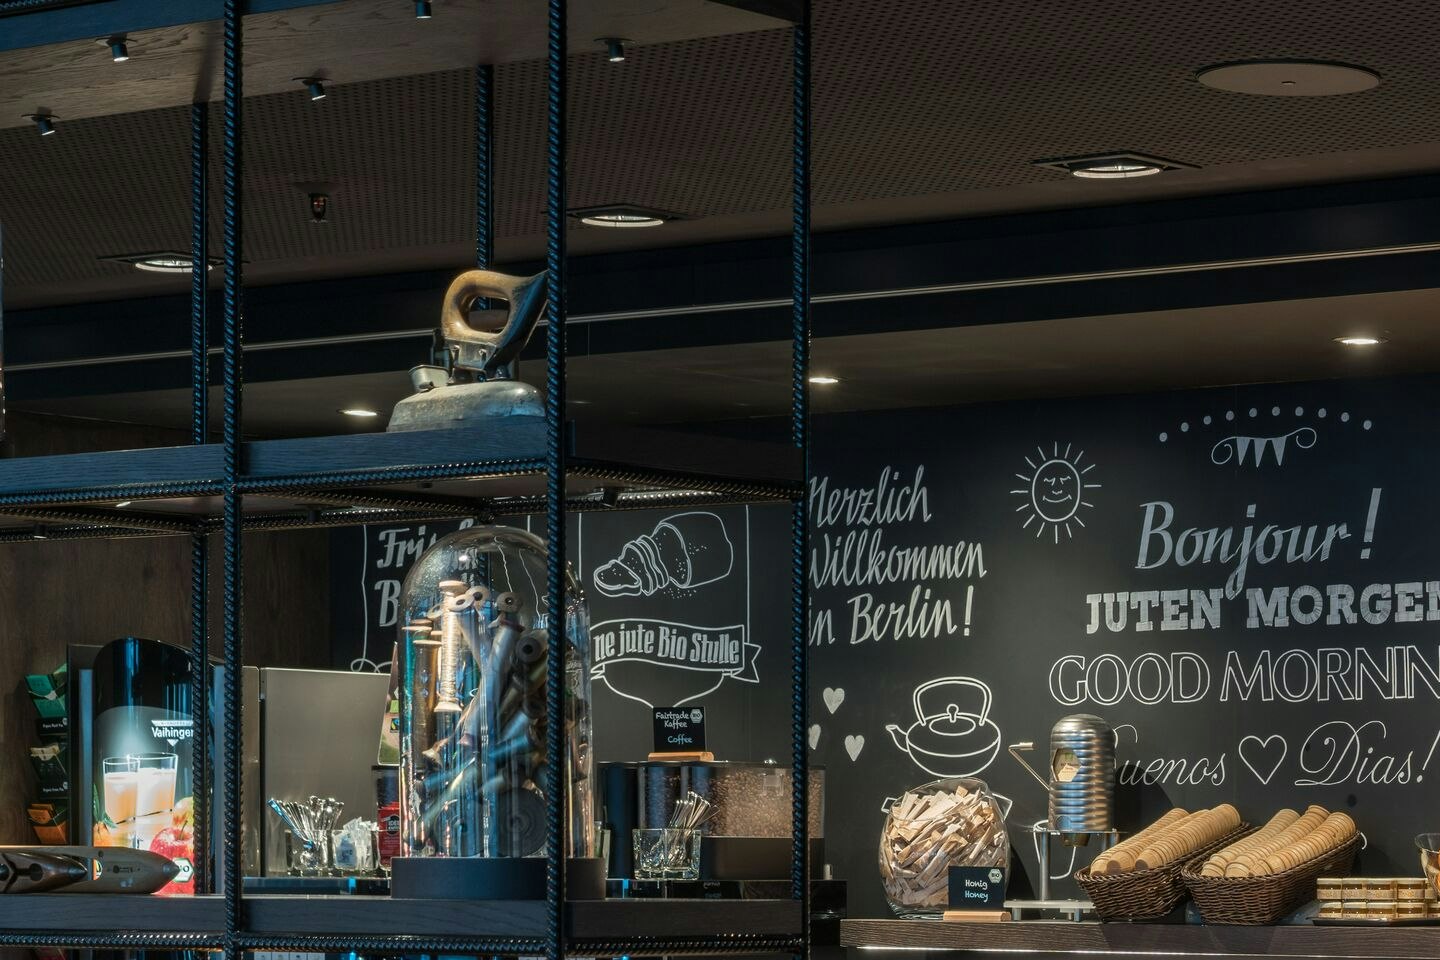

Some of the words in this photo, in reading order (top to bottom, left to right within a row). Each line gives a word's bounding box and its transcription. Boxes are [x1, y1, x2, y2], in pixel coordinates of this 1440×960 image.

[1086, 588, 1224, 634] JUTEN
[617, 623, 655, 657] jute
[657, 626, 688, 661] Bio
[689, 632, 740, 665] Stulle
[1049, 651, 1211, 707] GOOD
[667, 734, 693, 744] Coffee
[1114, 724, 1226, 786] uenos
[964, 890, 989, 903] Honey
[965, 880, 988, 890] Honig
